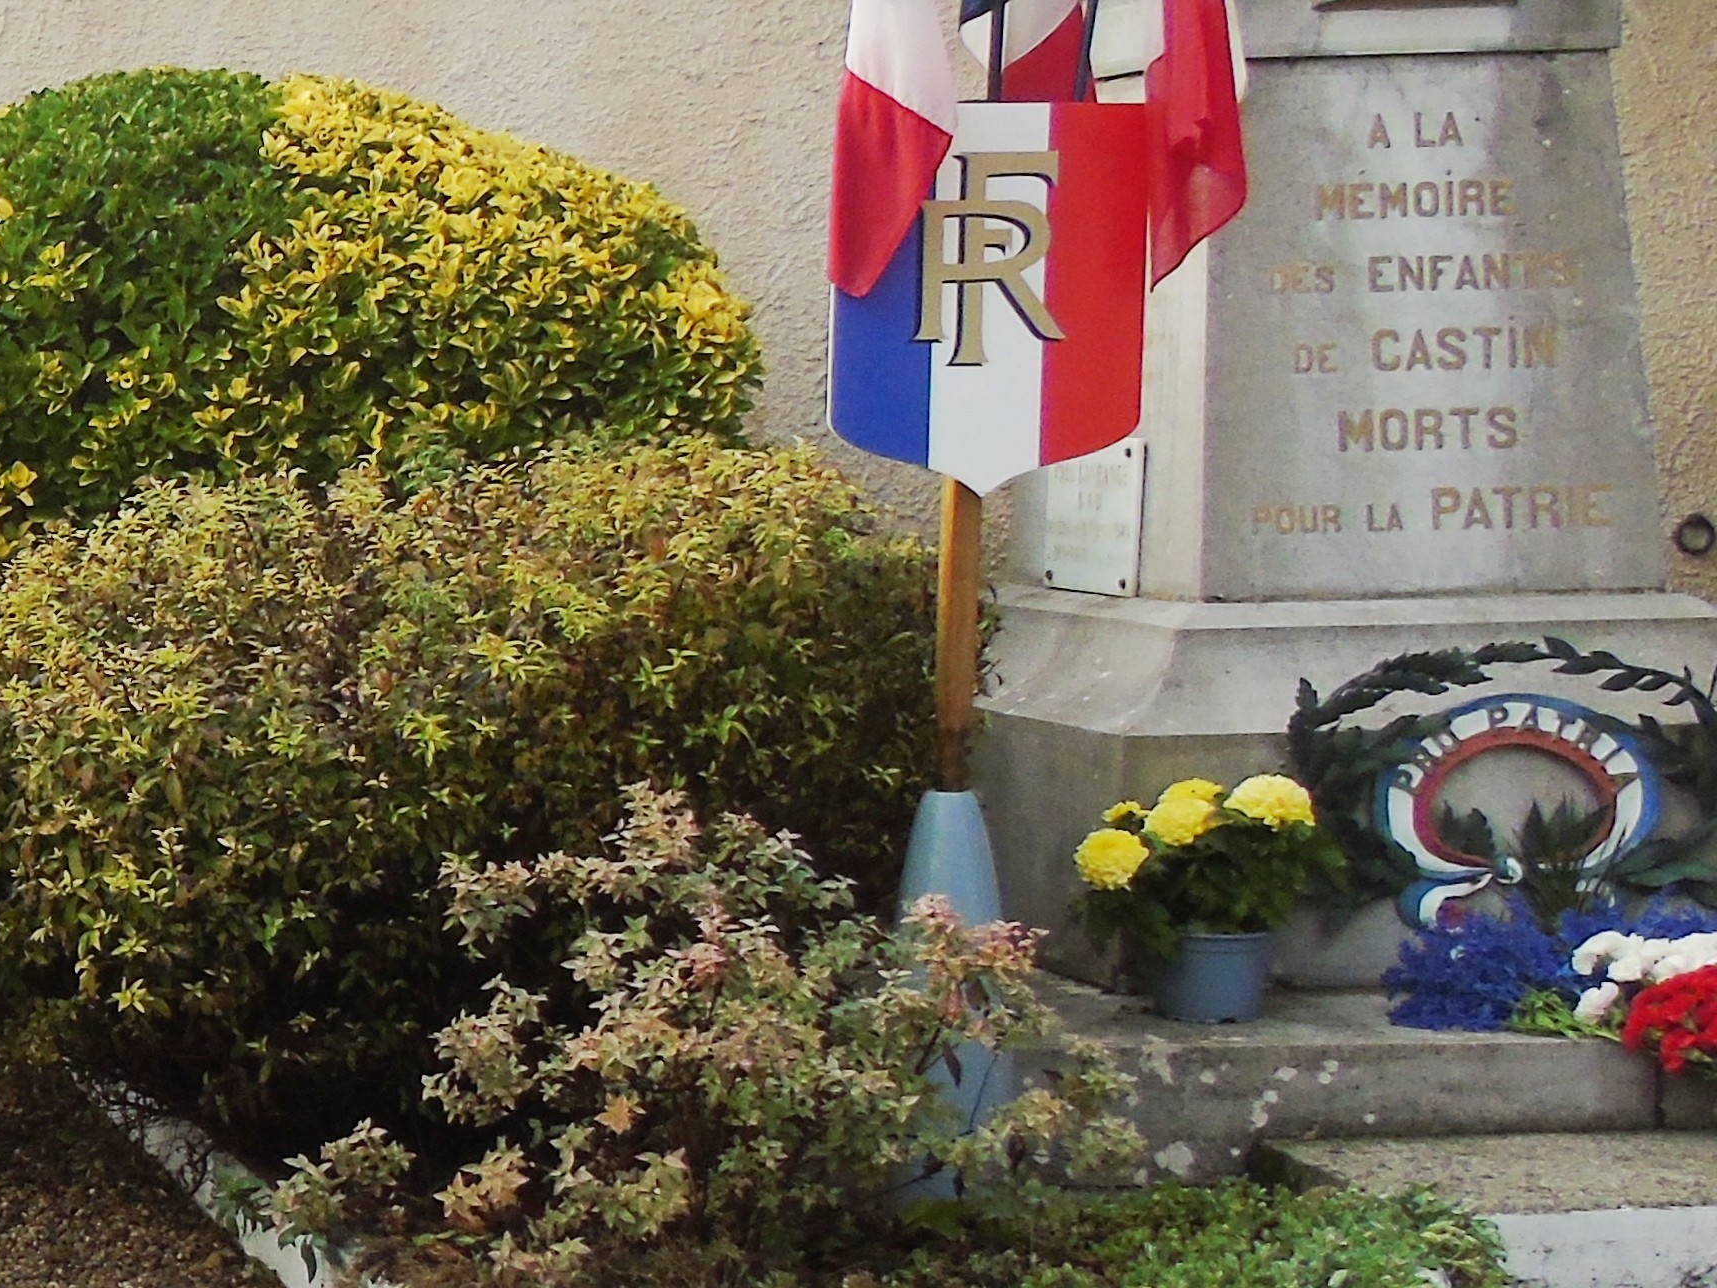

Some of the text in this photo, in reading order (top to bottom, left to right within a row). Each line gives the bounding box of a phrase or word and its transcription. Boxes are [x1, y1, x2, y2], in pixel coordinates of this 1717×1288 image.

[1414, 112, 1464, 148] LA
[1269, 252, 1577, 295] DES ENFANTS
[1294, 316, 1558, 374] DE CASTIN
[1337, 406, 1518, 453] MORTS
[1251, 482, 1616, 536] POUR LA PATRIE
